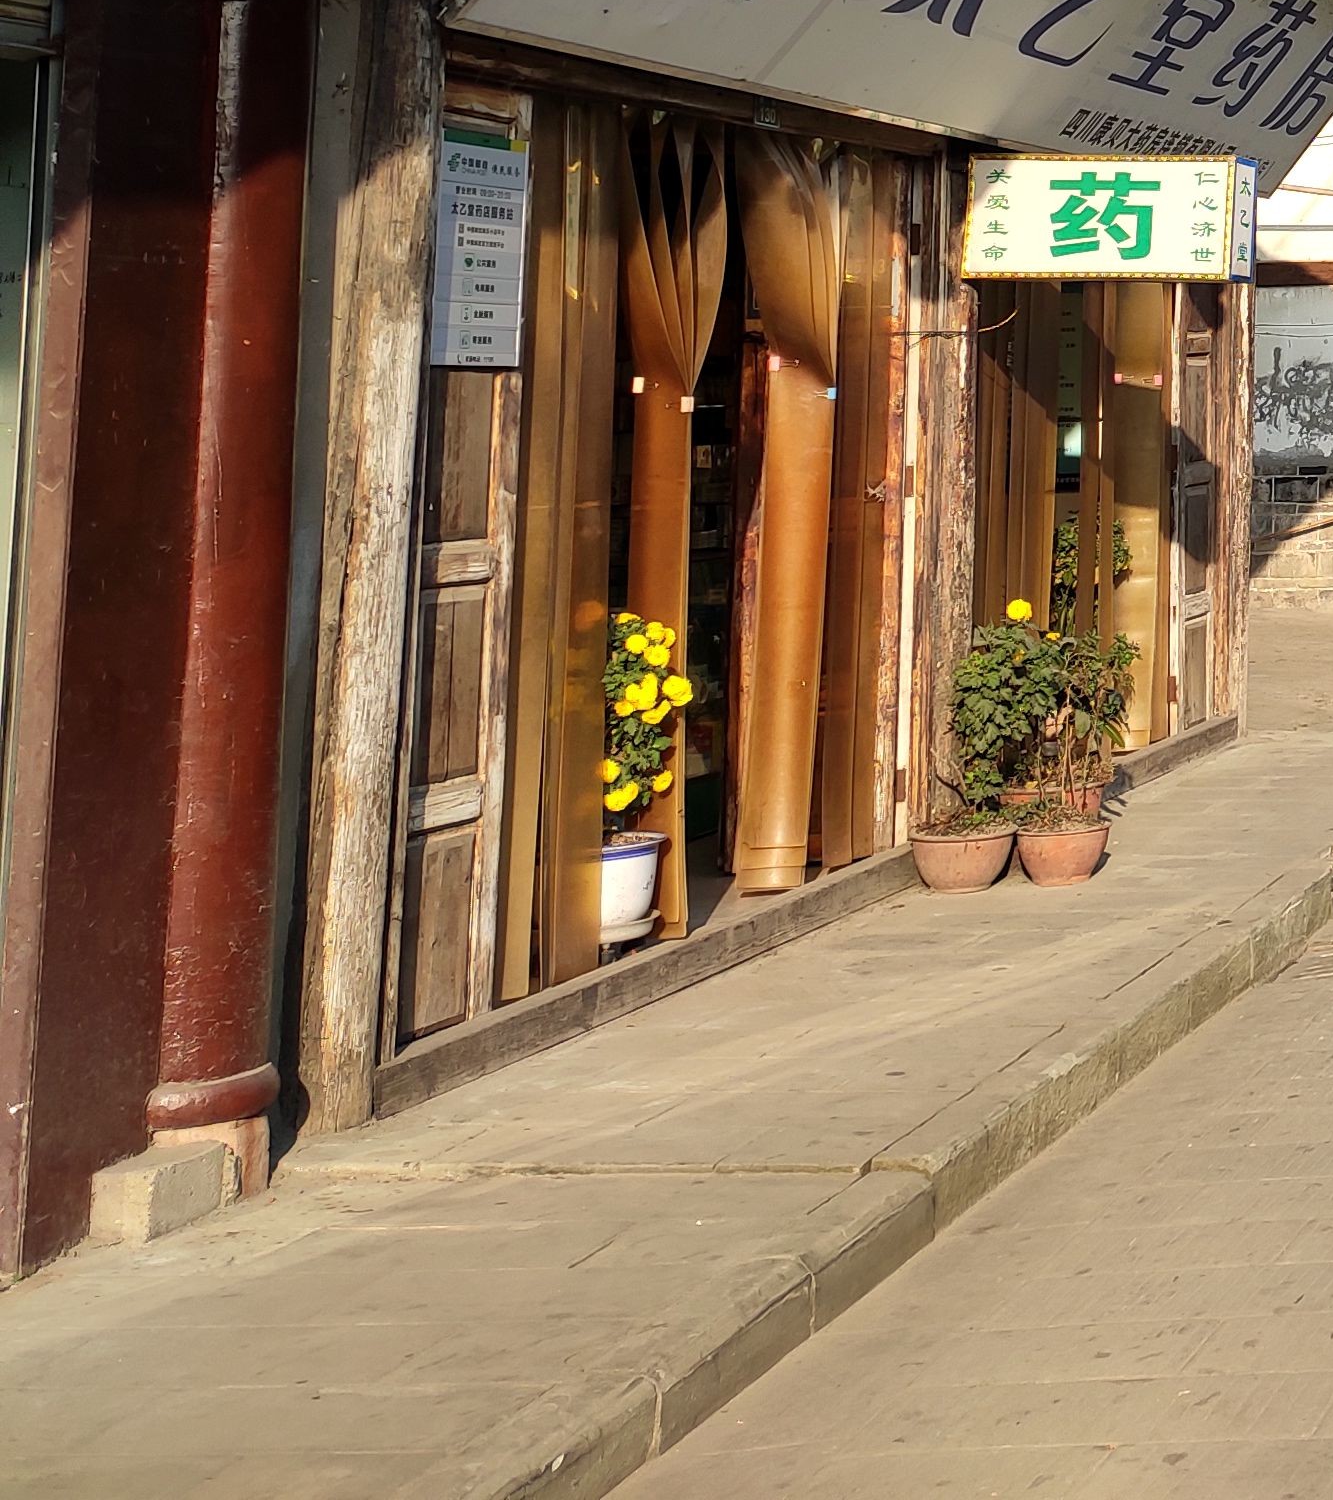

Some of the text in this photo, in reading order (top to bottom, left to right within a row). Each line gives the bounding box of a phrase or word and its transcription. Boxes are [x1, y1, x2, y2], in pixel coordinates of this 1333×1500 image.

[982, 168, 1012, 262] 关爱生命
[1049, 171, 1161, 261] 药
[1190, 171, 1220, 263] 仁心济世
[1236, 177, 1252, 263] 太乙堂
